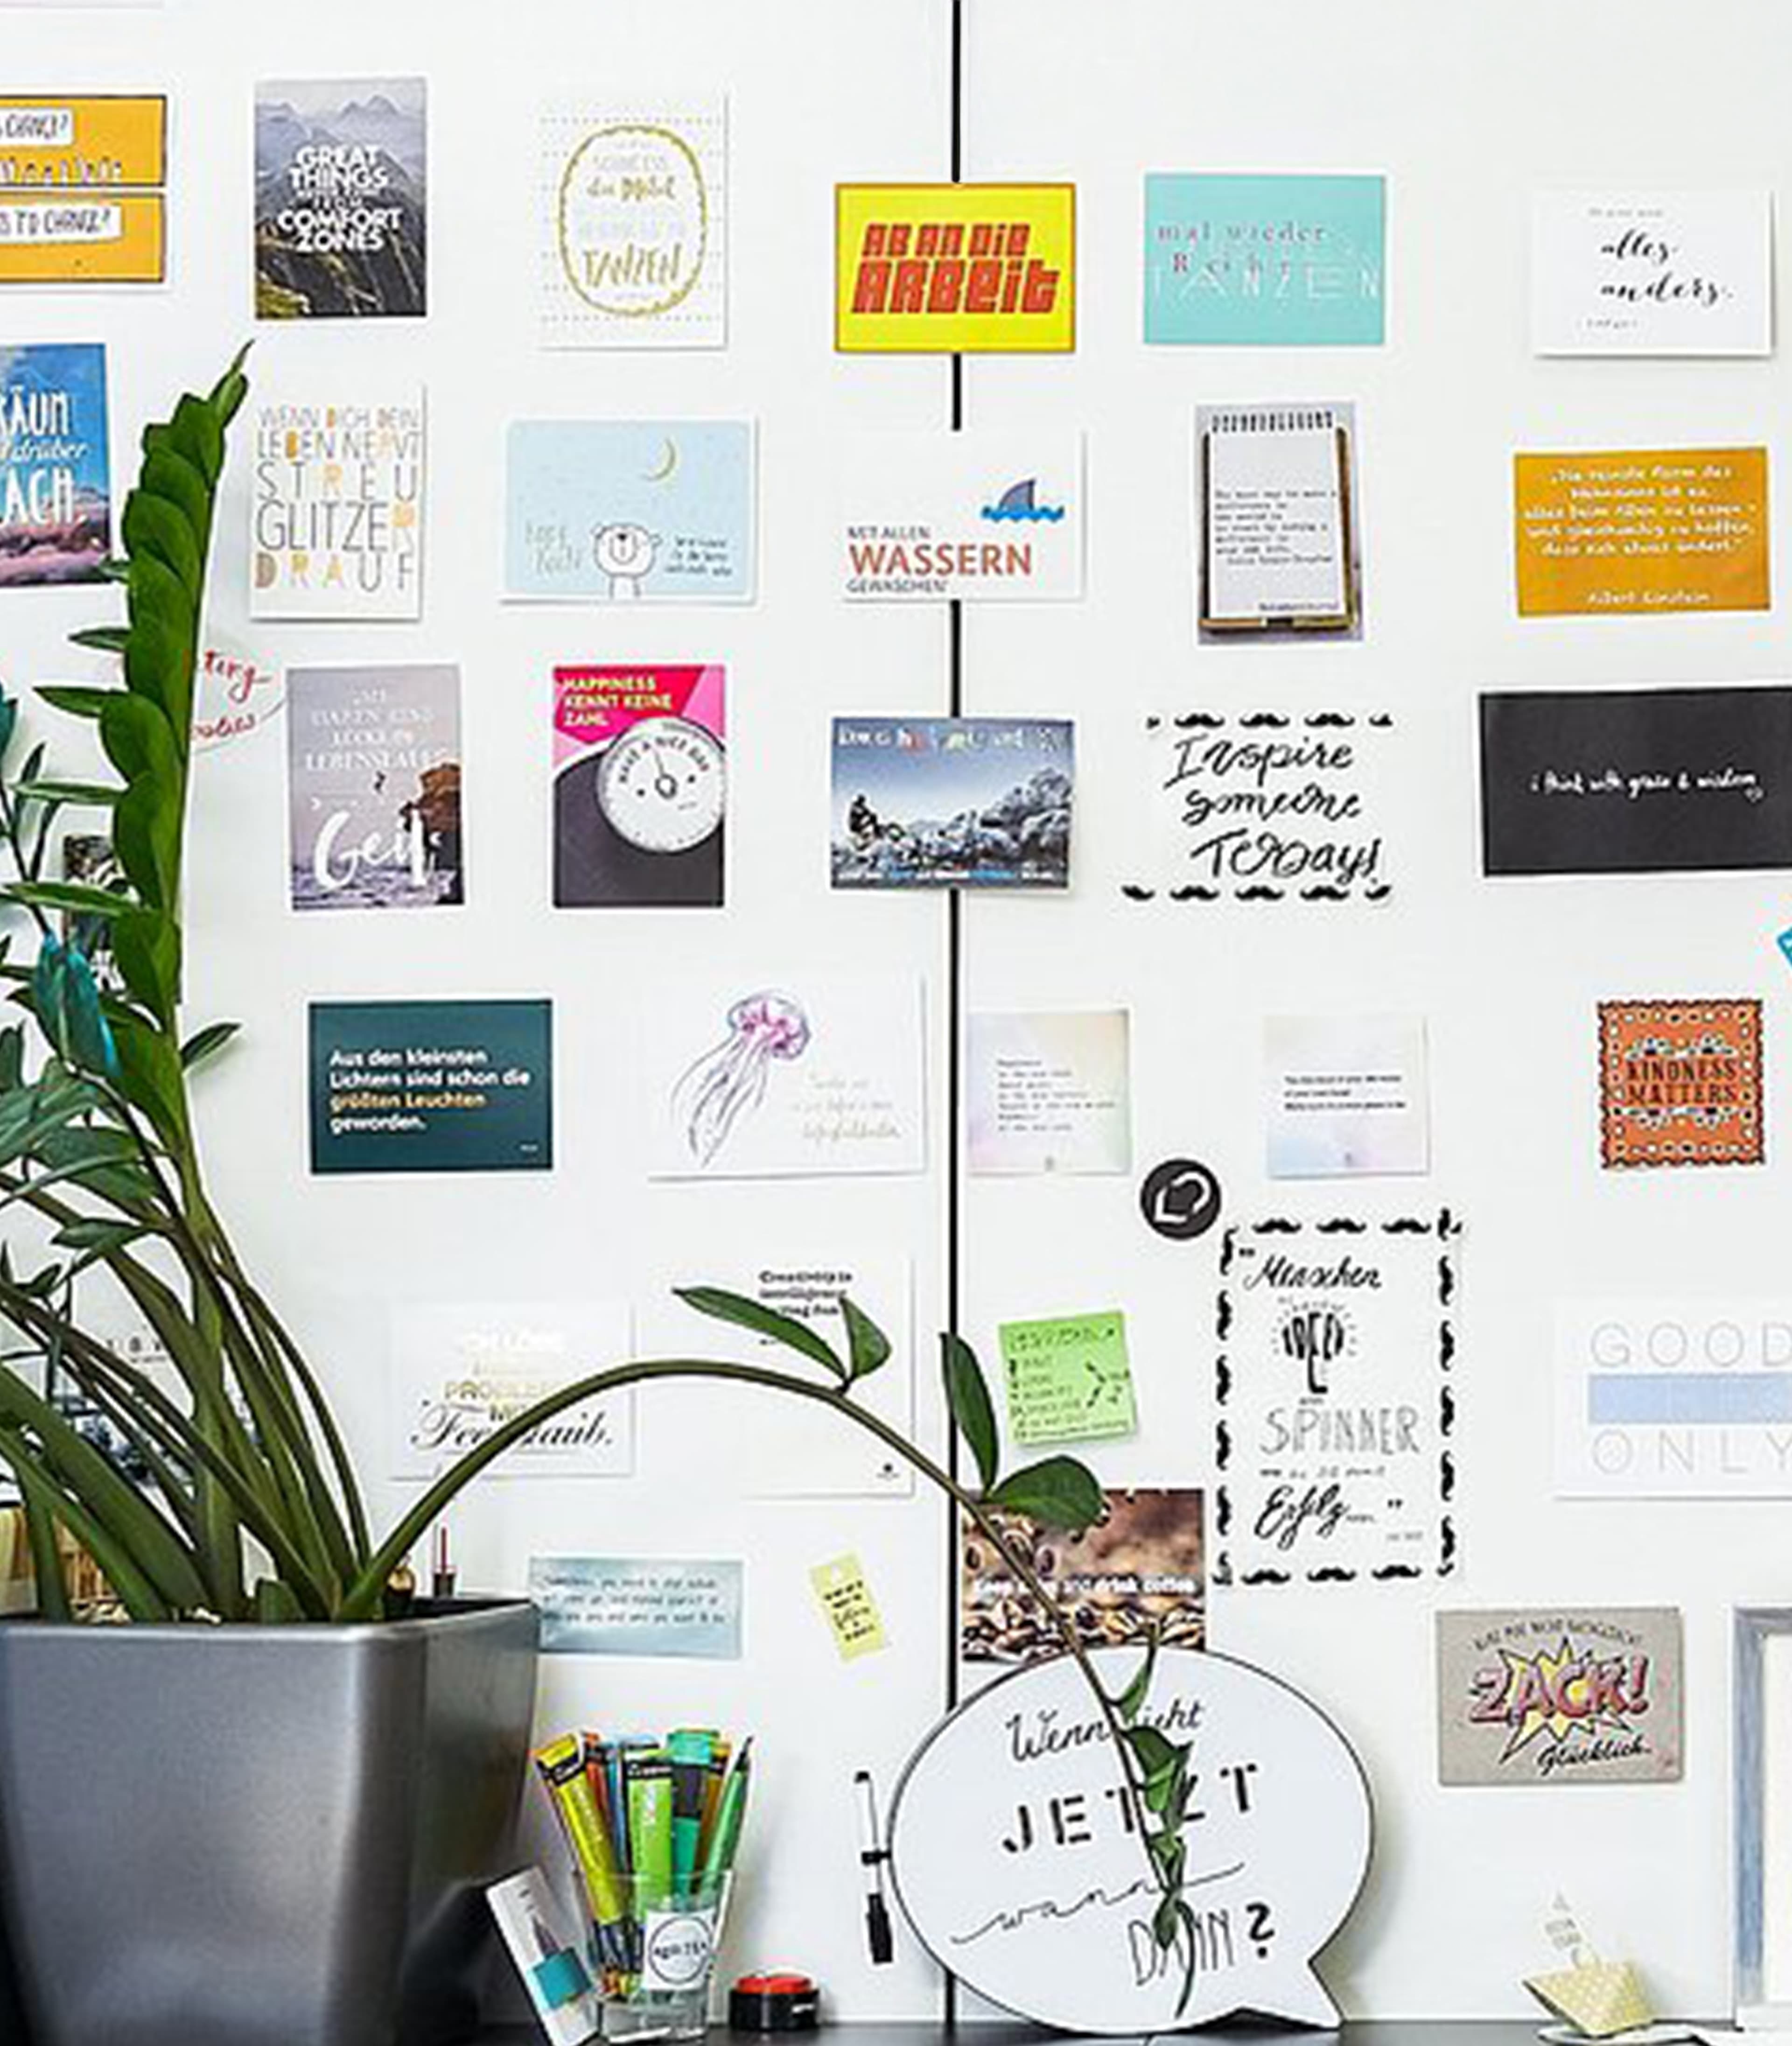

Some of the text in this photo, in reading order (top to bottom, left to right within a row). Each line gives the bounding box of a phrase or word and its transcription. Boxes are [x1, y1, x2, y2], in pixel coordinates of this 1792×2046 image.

[289, 166, 389, 189] THINGS
[278, 208, 403, 231] COMFORT
[296, 231, 385, 253] ZONES
[257, 430, 336, 459] LEBEN
[257, 460, 418, 501] STREU
[848, 543, 1032, 576] WASSERN
[256, 551, 413, 592] DRAUF
[564, 676, 656, 691] HAPPINESS
[563, 694, 672, 709] KENNT KEINE
[329, 1047, 488, 1067] Aus den kleinsten
[329, 1068, 531, 1088] Lichtern sind schon die
[1627, 1061, 1738, 1082] KINDNESS
[406, 1091, 487, 1110] Leuchten
[1627, 1083, 1739, 1105] MATTERS
[330, 1114, 427, 1135] geworden.
[1591, 1321, 1792, 1369] GOOD
[1260, 1406, 1421, 1455] SPINNER
[1592, 1428, 1792, 1475] ONLY
[1007, 1710, 1109, 1762] Wenn
